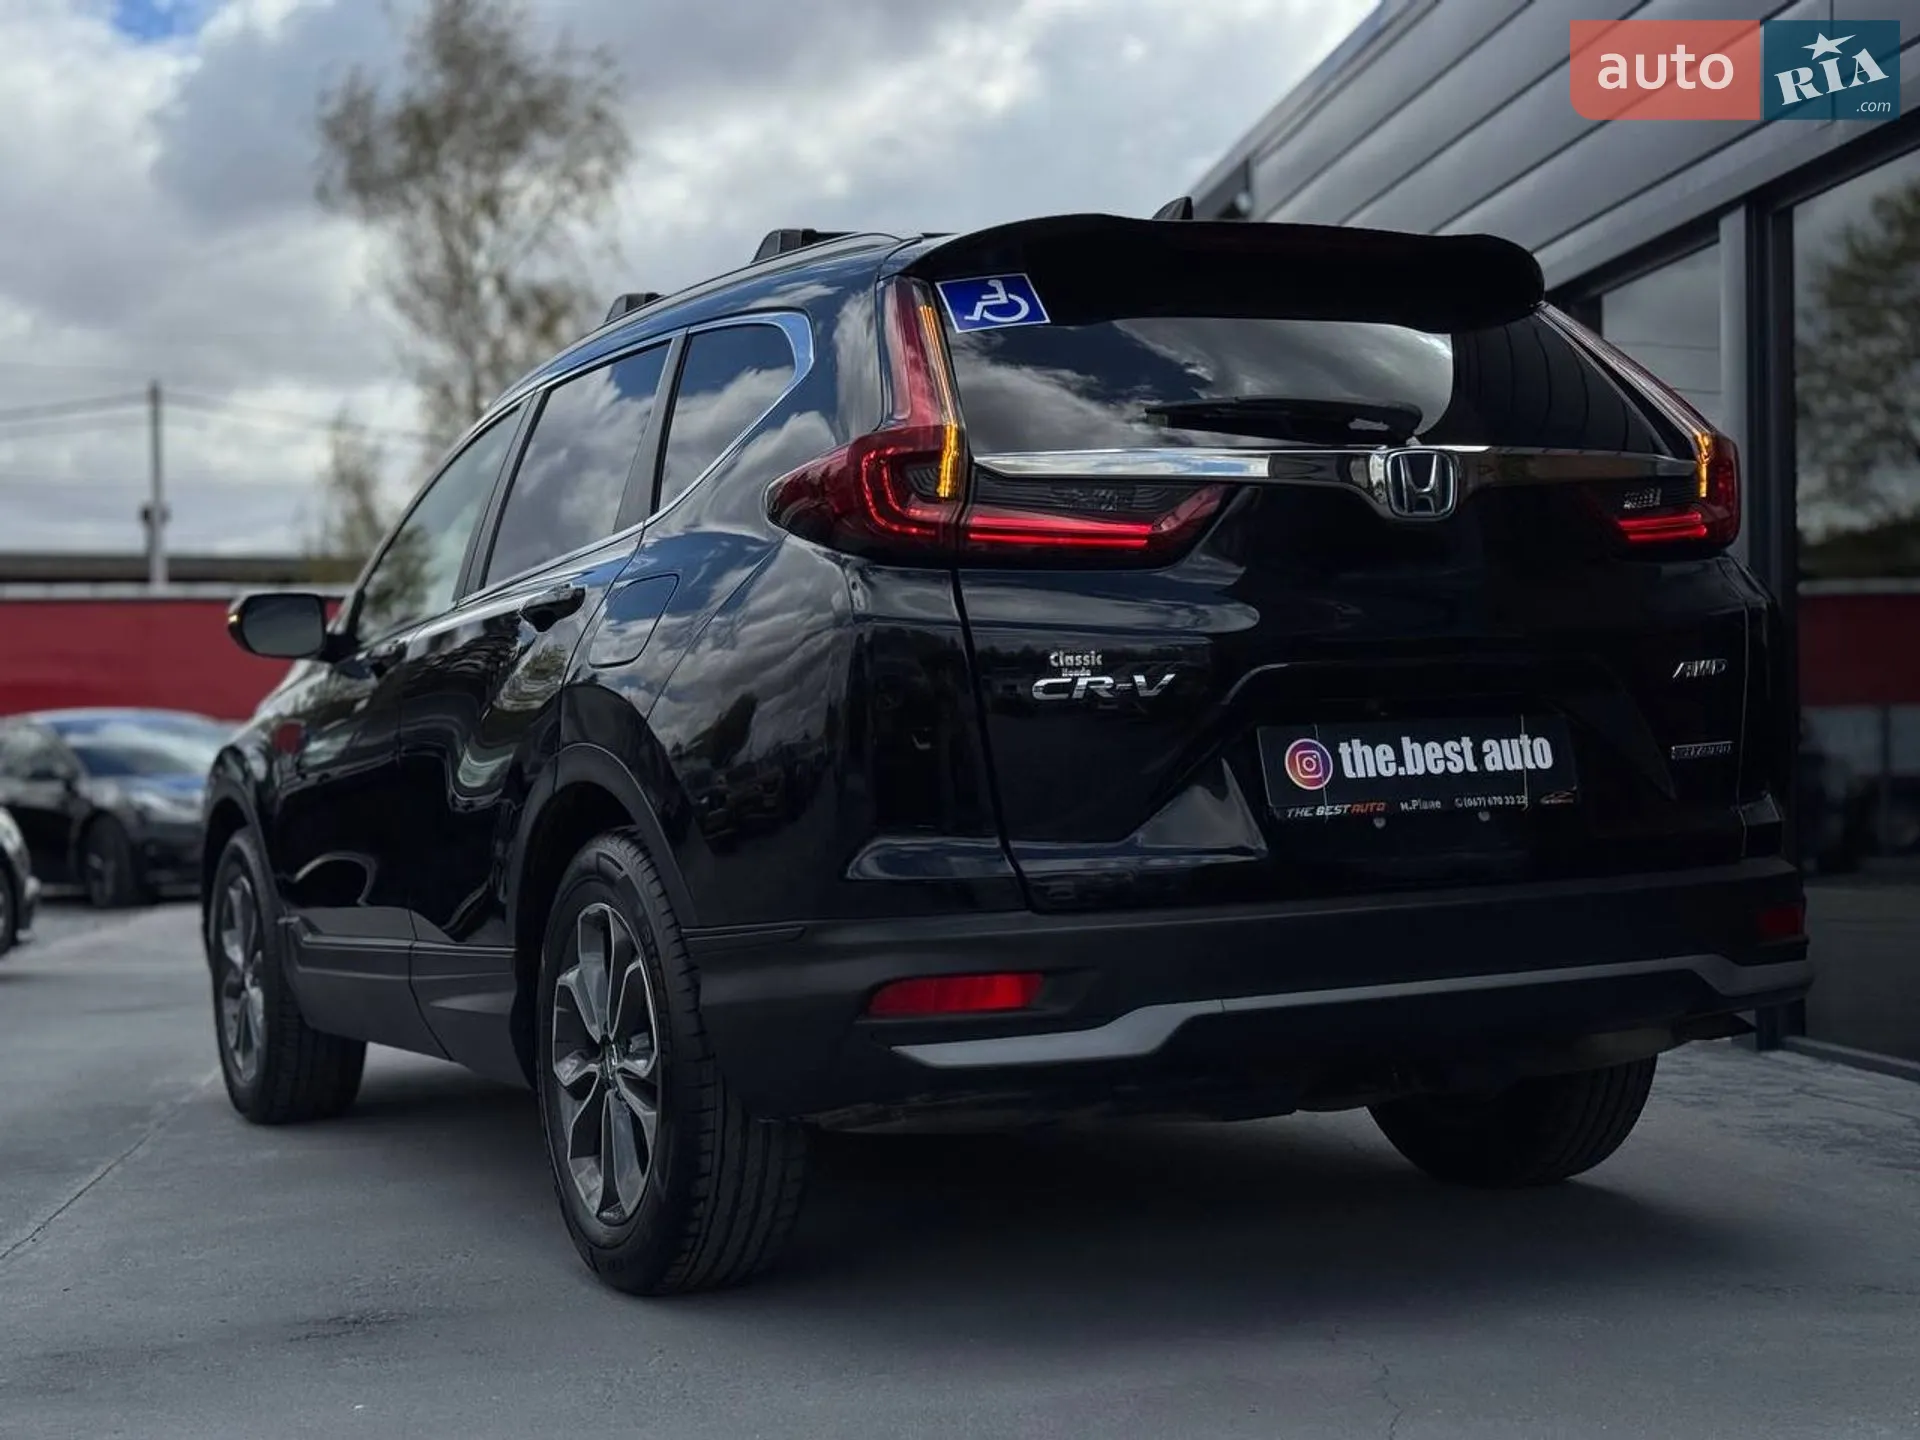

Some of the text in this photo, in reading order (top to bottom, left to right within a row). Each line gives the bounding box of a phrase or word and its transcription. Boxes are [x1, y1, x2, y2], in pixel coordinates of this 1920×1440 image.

[1049, 650, 1103, 667] Classic
[1031, 673, 1176, 700] CR-V
[1339, 734, 1553, 777] the.best auto
[1286, 806, 1315, 818] THE
[1315, 803, 1352, 816] BEST
